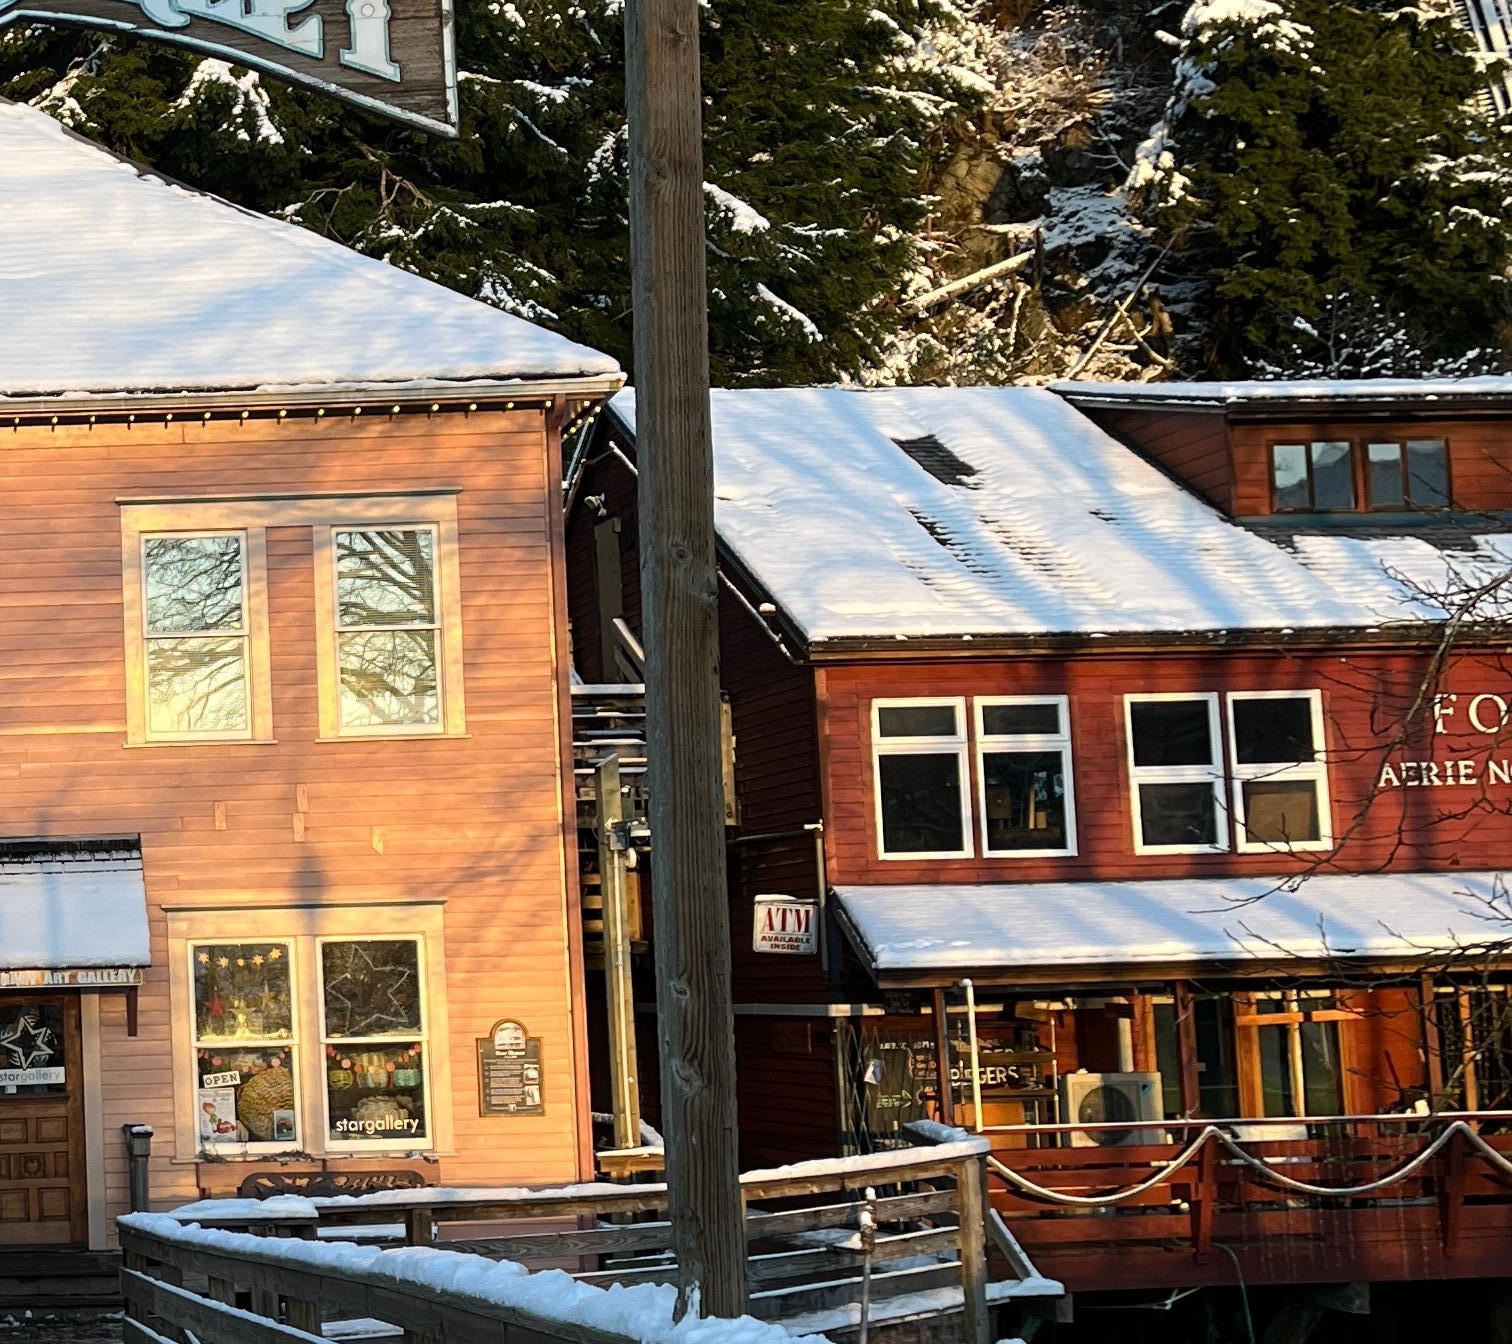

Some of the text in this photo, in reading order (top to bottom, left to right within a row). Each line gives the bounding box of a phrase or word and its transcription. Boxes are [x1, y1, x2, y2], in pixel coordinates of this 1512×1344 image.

[1377, 759, 1512, 788] AERIE N
[760, 907, 811, 934] ATM
[760, 935, 811, 944] AVAILABLE
[770, 943, 801, 951] INSIDE
[43, 970, 71, 985] ART
[76, 968, 137, 984] GALLERY
[0, 1068, 61, 1084] stargallery
[205, 1073, 238, 1086] OPEN
[335, 1115, 419, 1134] stargallery
